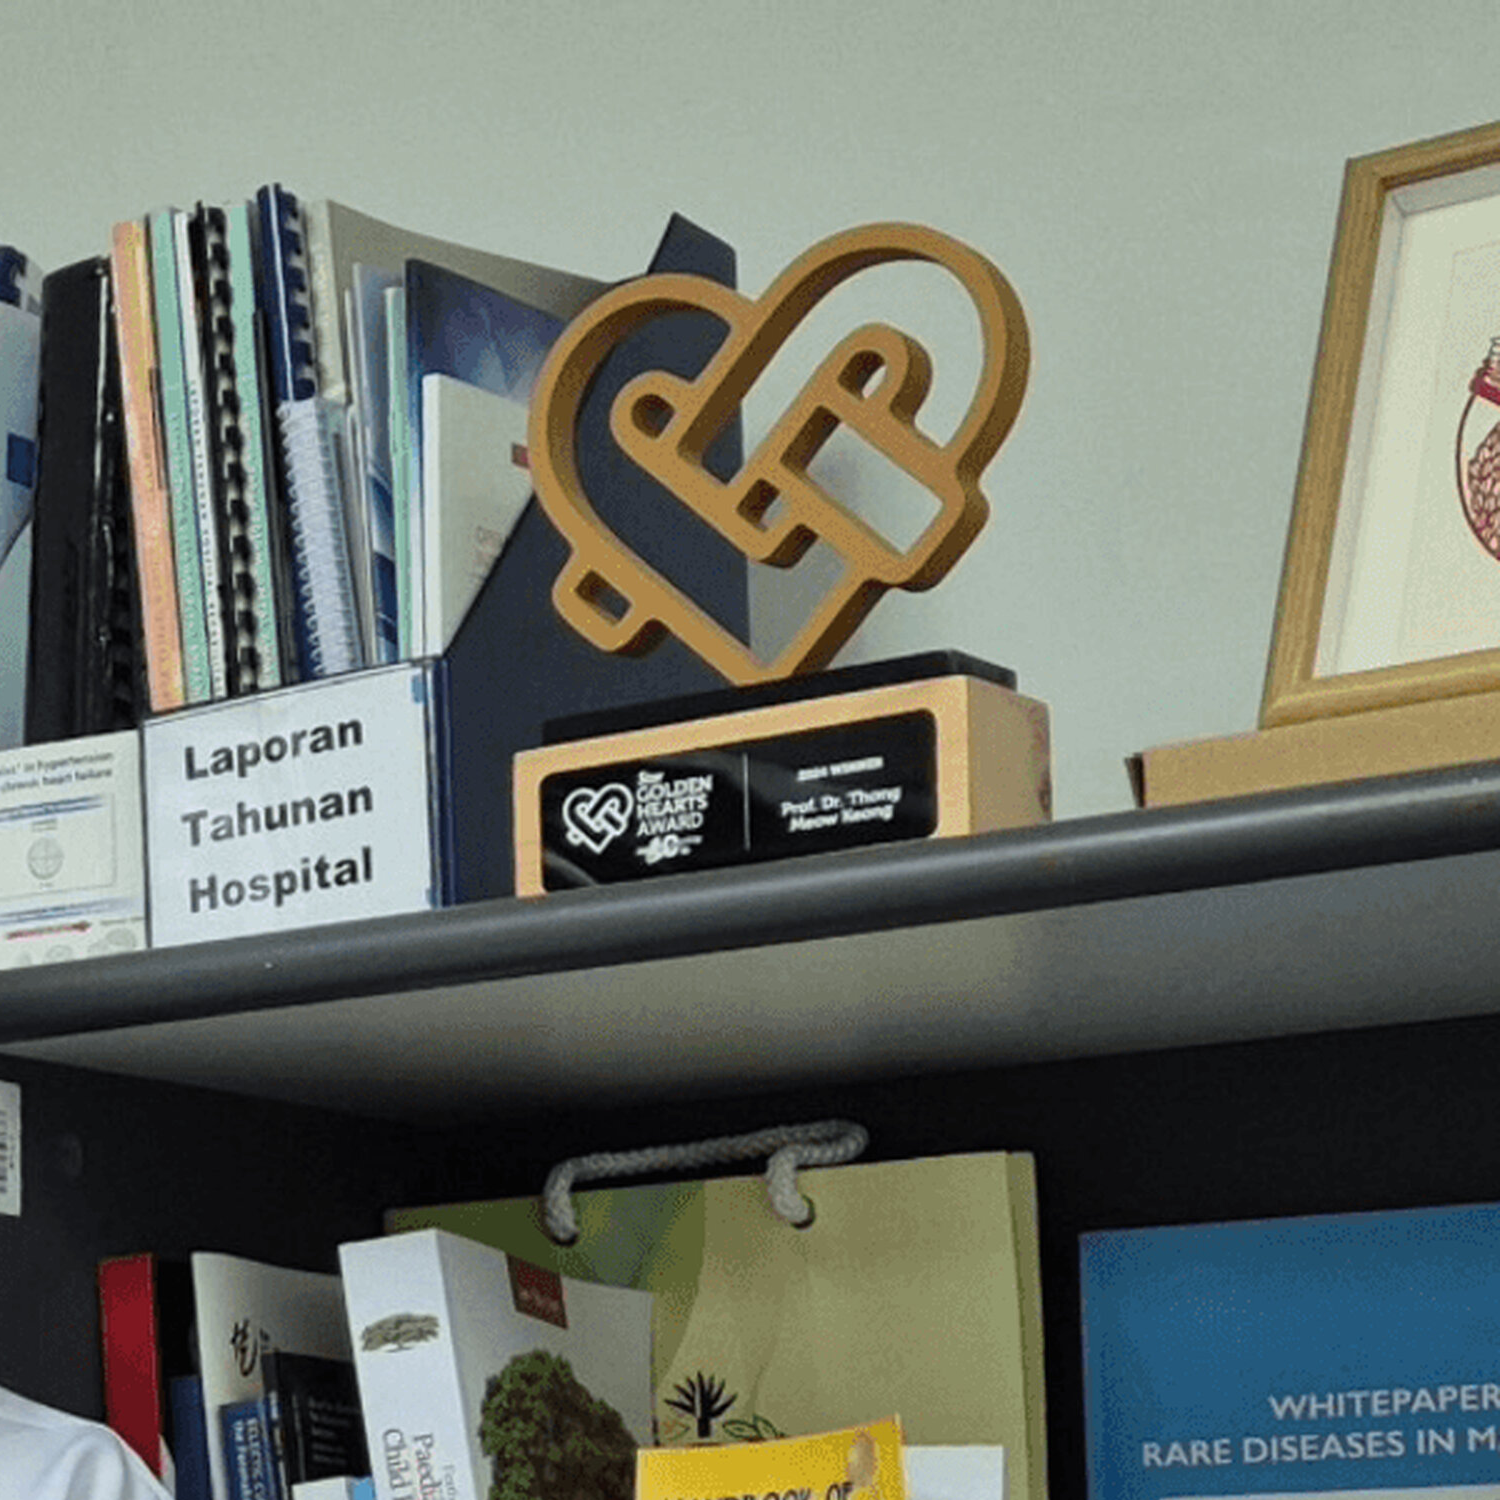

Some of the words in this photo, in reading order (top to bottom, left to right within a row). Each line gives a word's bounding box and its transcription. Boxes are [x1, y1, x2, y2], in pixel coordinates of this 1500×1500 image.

[184, 719, 363, 780] Laporan
[636, 775, 713, 801] GOLDEN
[637, 793, 708, 819] HEARTS
[181, 785, 372, 847] Tahunan
[636, 812, 703, 836] AWARD
[189, 845, 372, 913] Hospital
[1268, 1383, 1500, 1420] WHITEPAPER
[382, 1429, 412, 1490] Child
[1142, 1438, 1233, 1468] RARE
[1242, 1430, 1405, 1466] DISEASES
[1417, 1427, 1455, 1456] IN
[1467, 1423, 1500, 1453] M
